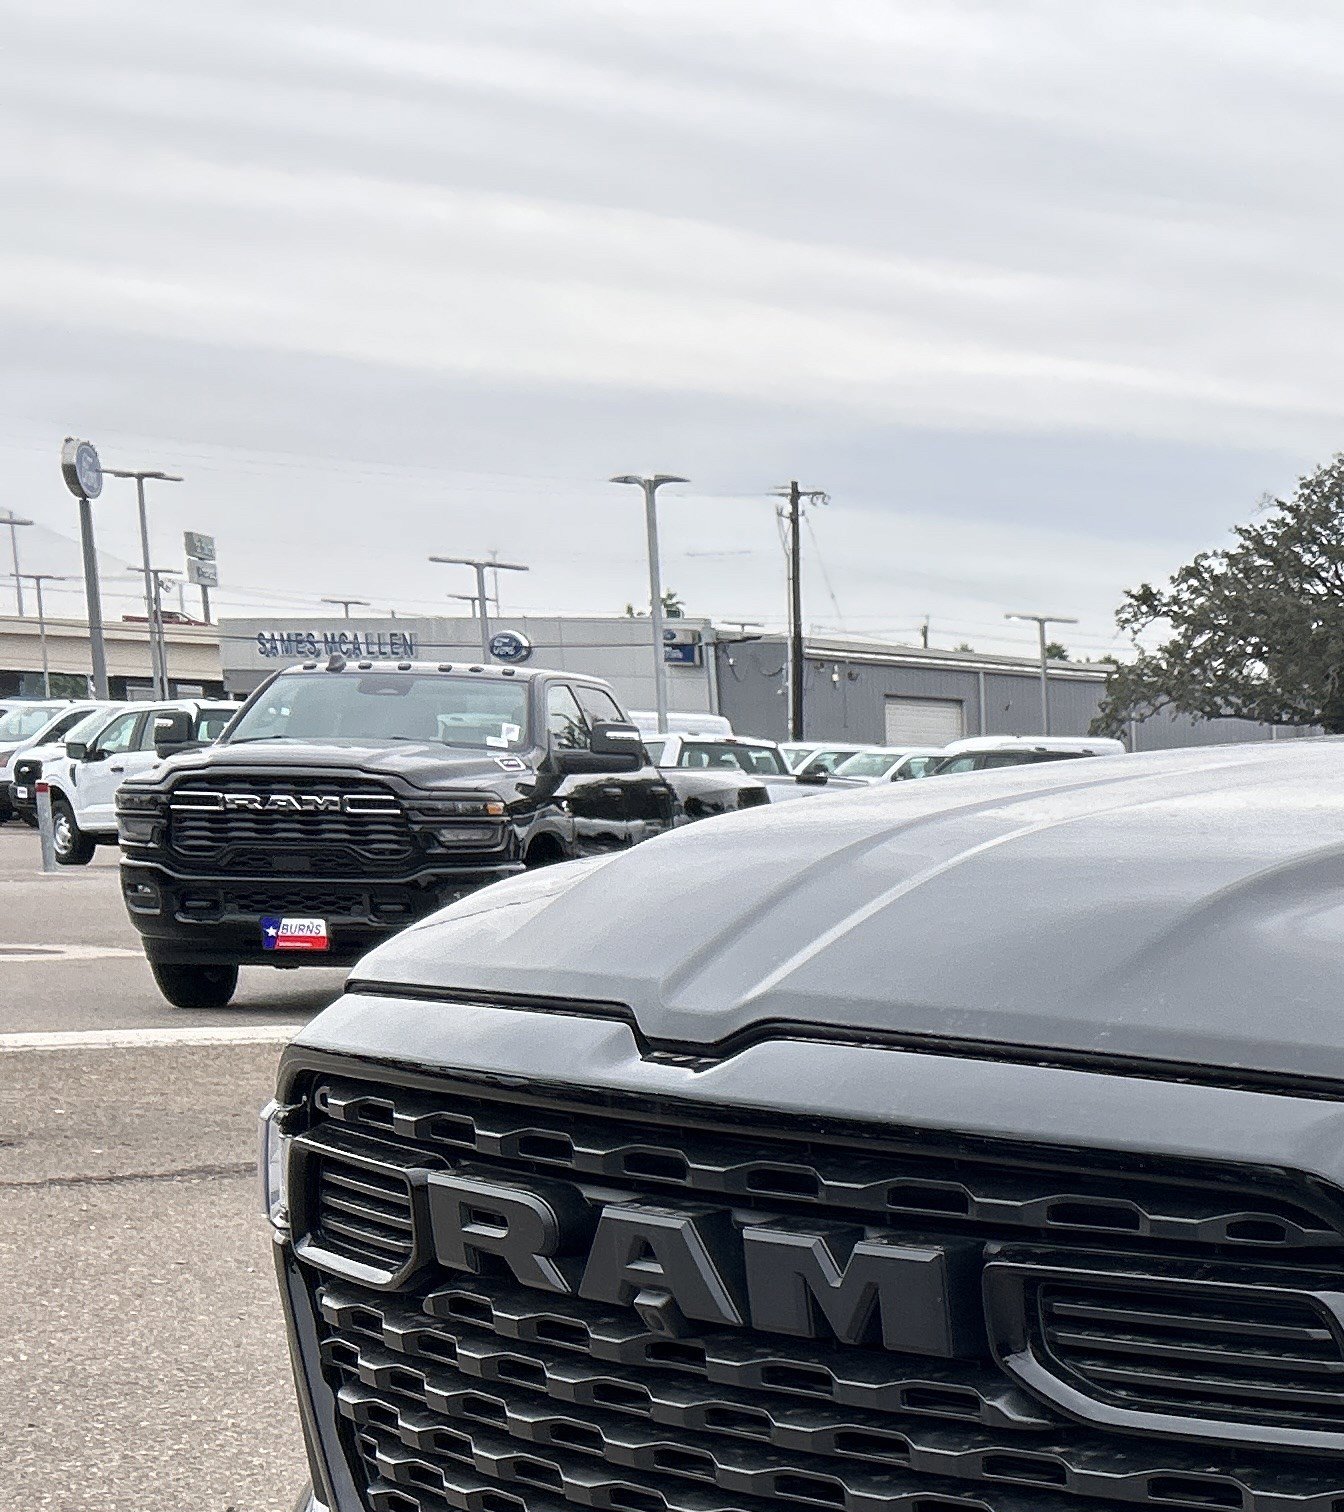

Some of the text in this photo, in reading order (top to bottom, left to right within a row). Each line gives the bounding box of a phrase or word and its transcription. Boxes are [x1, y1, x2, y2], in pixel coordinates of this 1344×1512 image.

[257, 632, 415, 657] SAMES MCALLEN
[224, 794, 340, 811] RAM
[281, 922, 322, 936] BURNS
[427, 1166, 958, 1359] RAM
